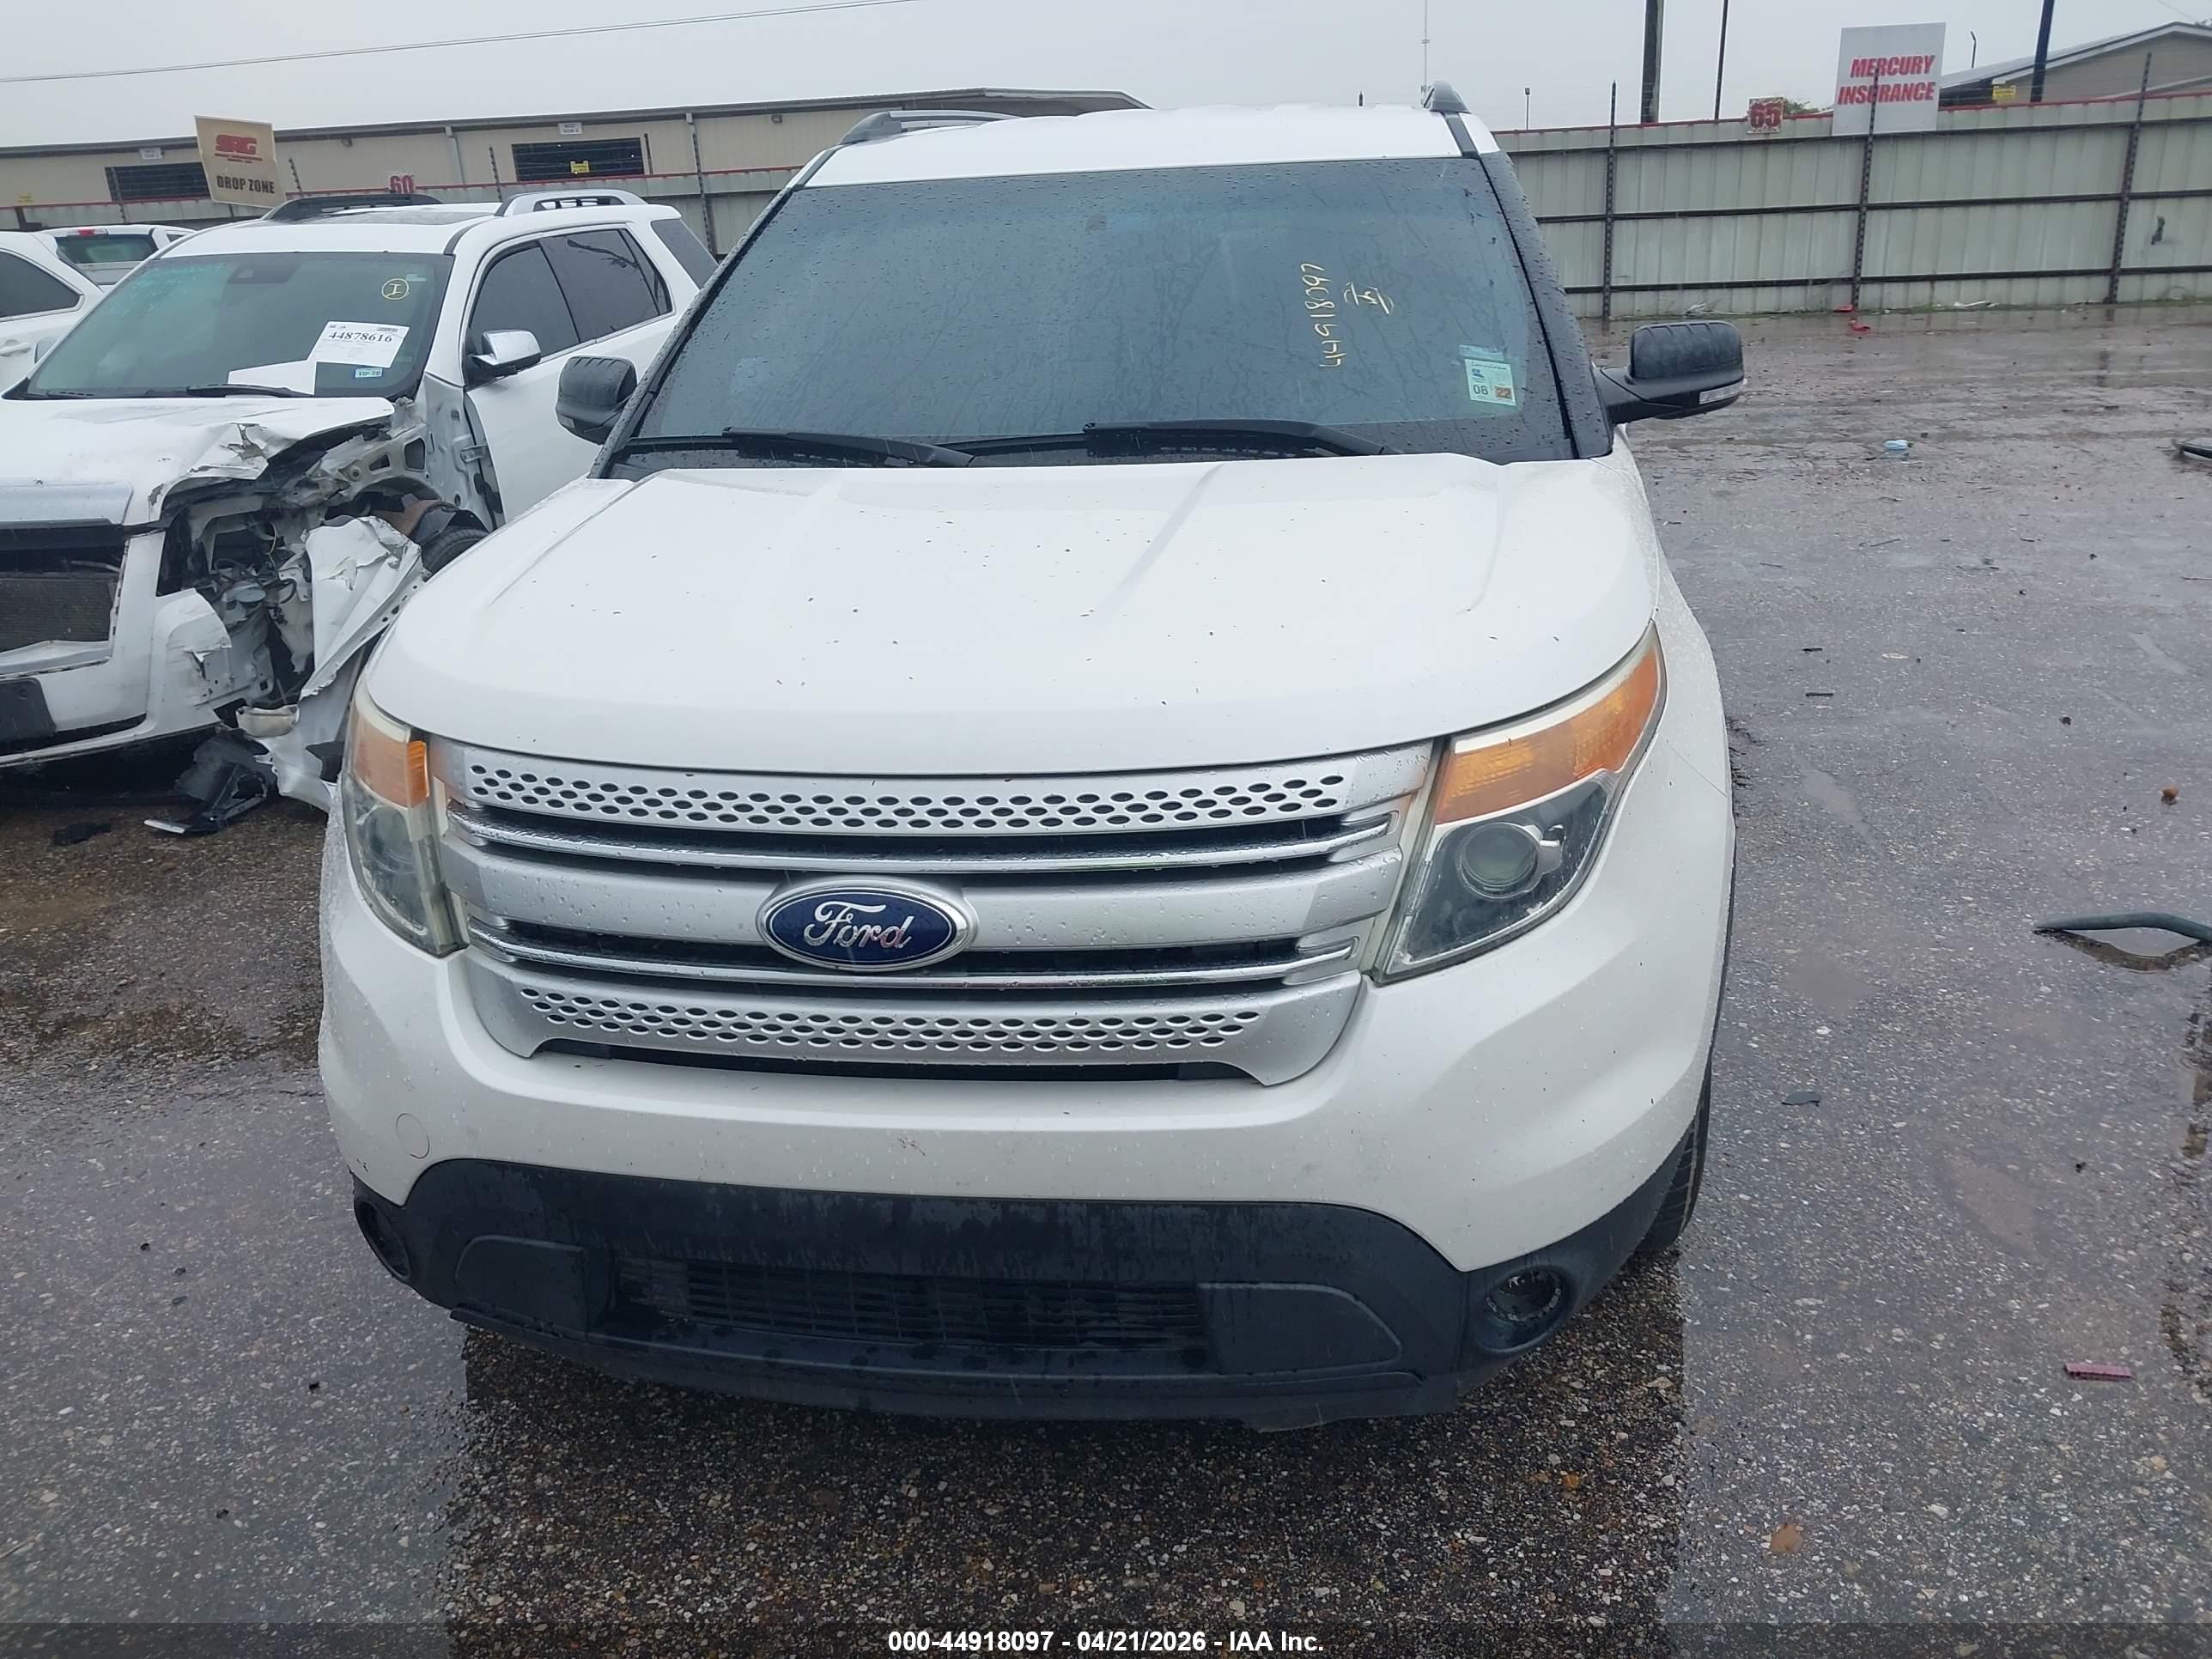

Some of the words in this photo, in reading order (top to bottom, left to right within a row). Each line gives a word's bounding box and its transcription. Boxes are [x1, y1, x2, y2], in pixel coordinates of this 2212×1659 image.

[1850, 55, 1936, 78] MERCURY
[1838, 82, 1936, 105] INSURANCE
[1750, 102, 1782, 129] 65
[216, 175, 246, 191] DROP
[247, 179, 276, 194] ZONE
[389, 174, 414, 194] 60
[1301, 263, 1347, 368] 44918097
[328, 331, 392, 343] 44878616
[1473, 384, 1489, 395] 08
[1496, 386, 1512, 399] 22
[804, 901, 915, 949] Ford
